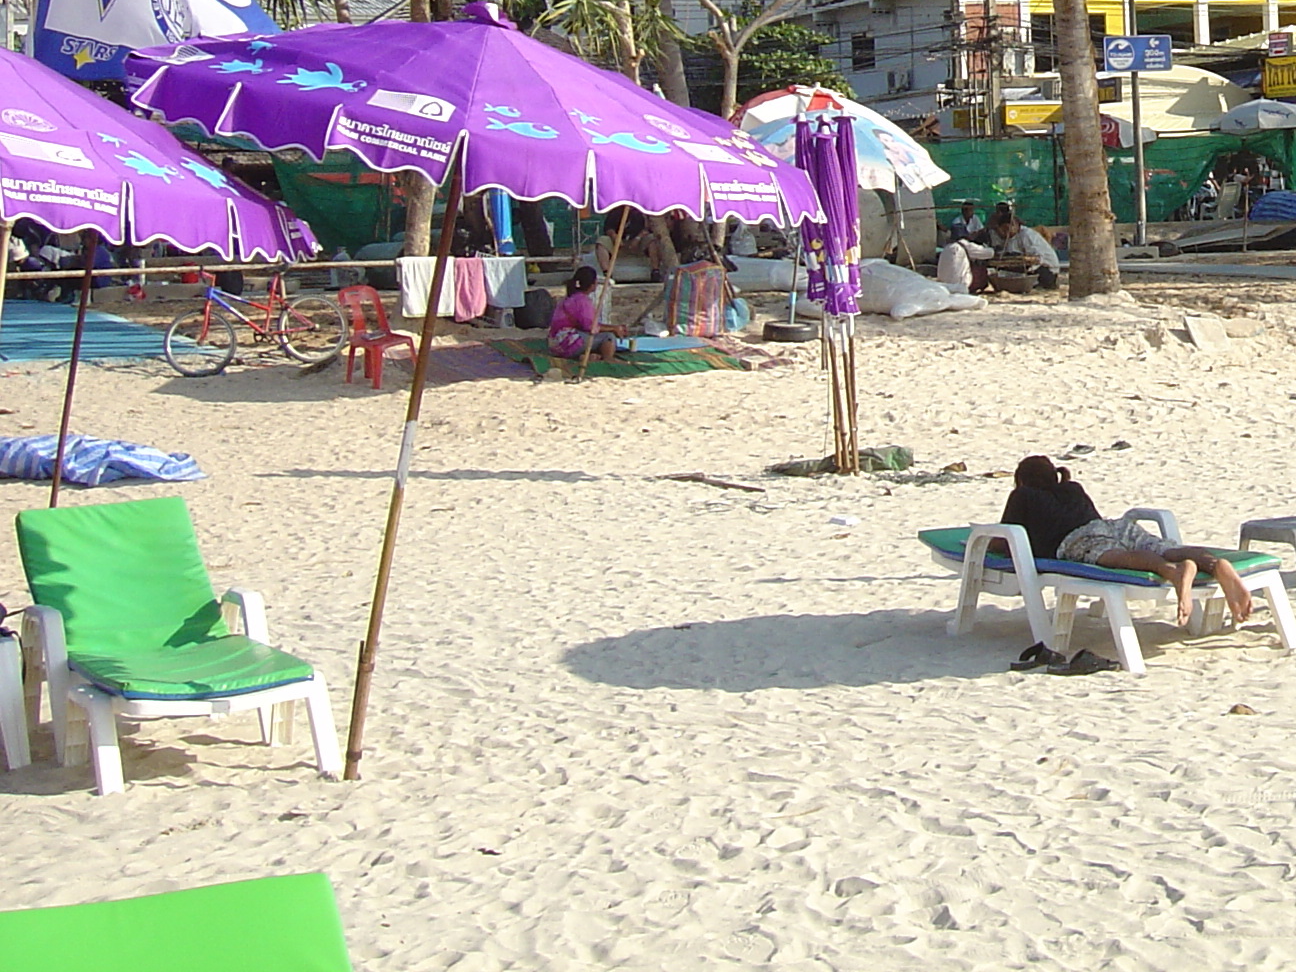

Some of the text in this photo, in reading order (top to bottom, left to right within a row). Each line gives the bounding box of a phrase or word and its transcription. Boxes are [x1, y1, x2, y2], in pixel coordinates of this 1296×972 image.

[61, 36, 119, 61] STARS
[360, 134, 419, 156] COMMERCIAL
[419, 149, 448, 164] BANK
